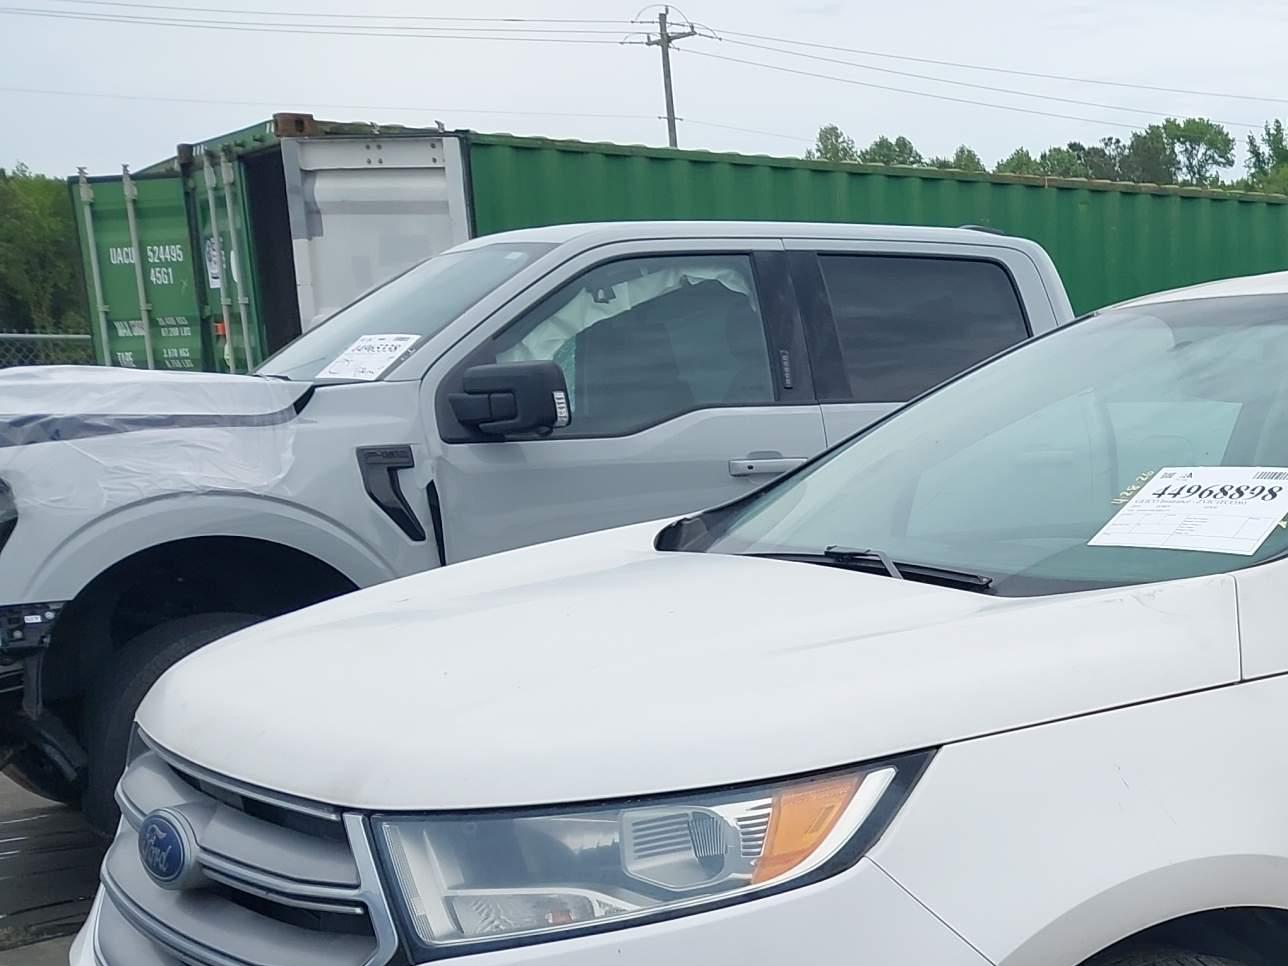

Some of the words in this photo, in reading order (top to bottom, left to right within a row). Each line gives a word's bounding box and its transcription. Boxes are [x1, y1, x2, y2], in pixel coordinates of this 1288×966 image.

[146, 245, 184, 263] 524495
[150, 267, 174, 285] 45G1
[1152, 483, 1283, 501] 44968898
[144, 823, 172, 873] Ford
